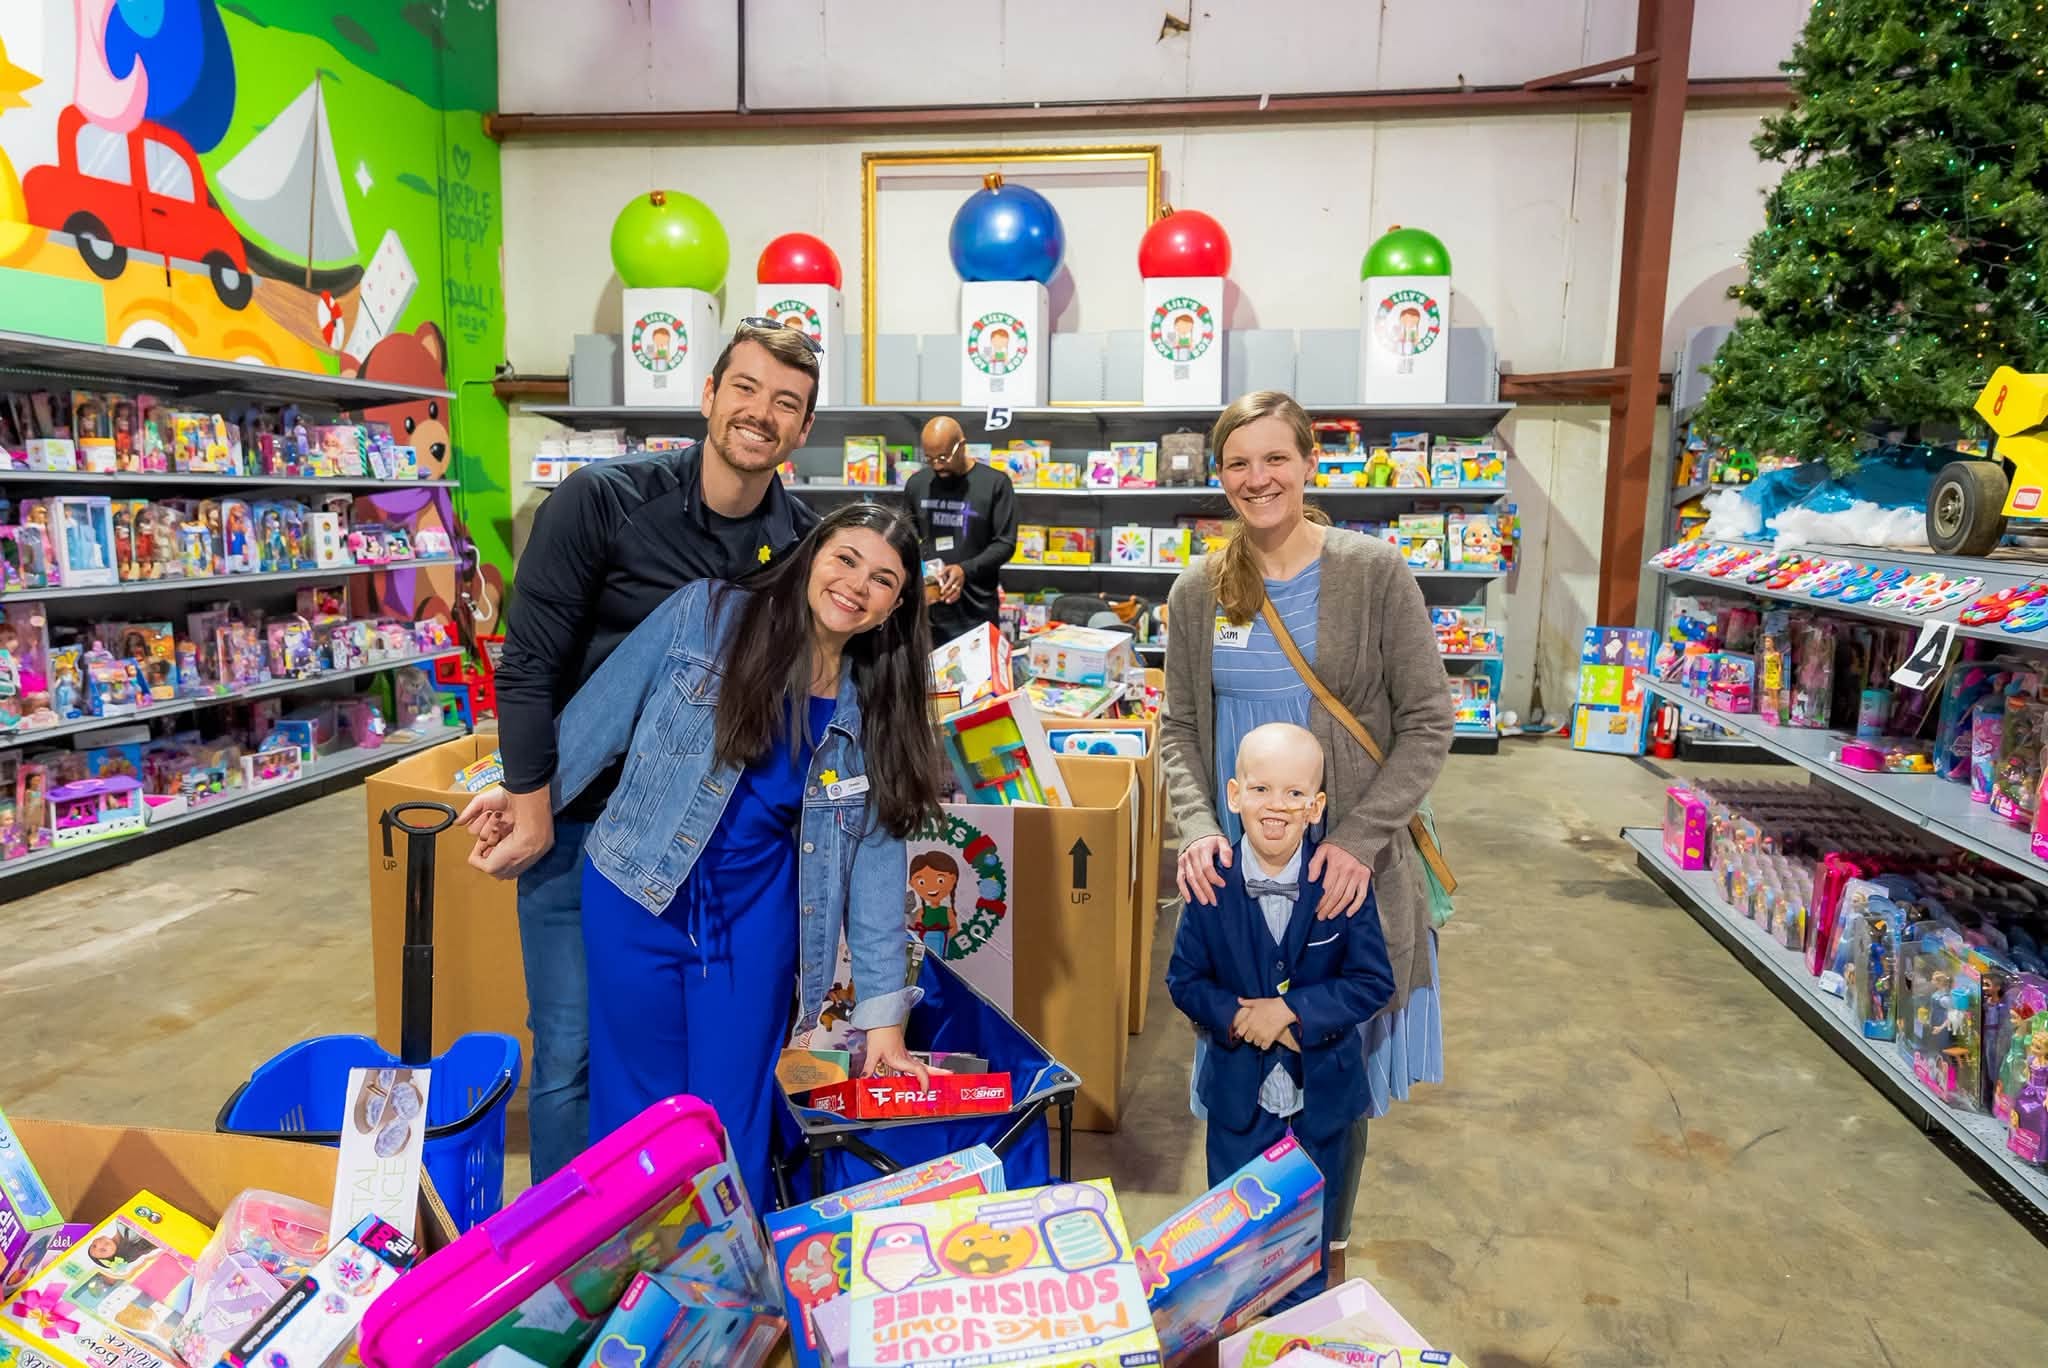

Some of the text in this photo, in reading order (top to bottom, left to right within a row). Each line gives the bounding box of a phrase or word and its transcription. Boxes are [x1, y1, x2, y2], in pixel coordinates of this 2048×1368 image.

[1994, 385, 2007, 416] 8
[990, 408, 1009, 427] 5
[1219, 625, 1239, 640] Sam
[1904, 625, 1949, 686] 4
[383, 859, 397, 870] UP
[1071, 892, 1092, 905] UP
[955, 908, 997, 950] BOX
